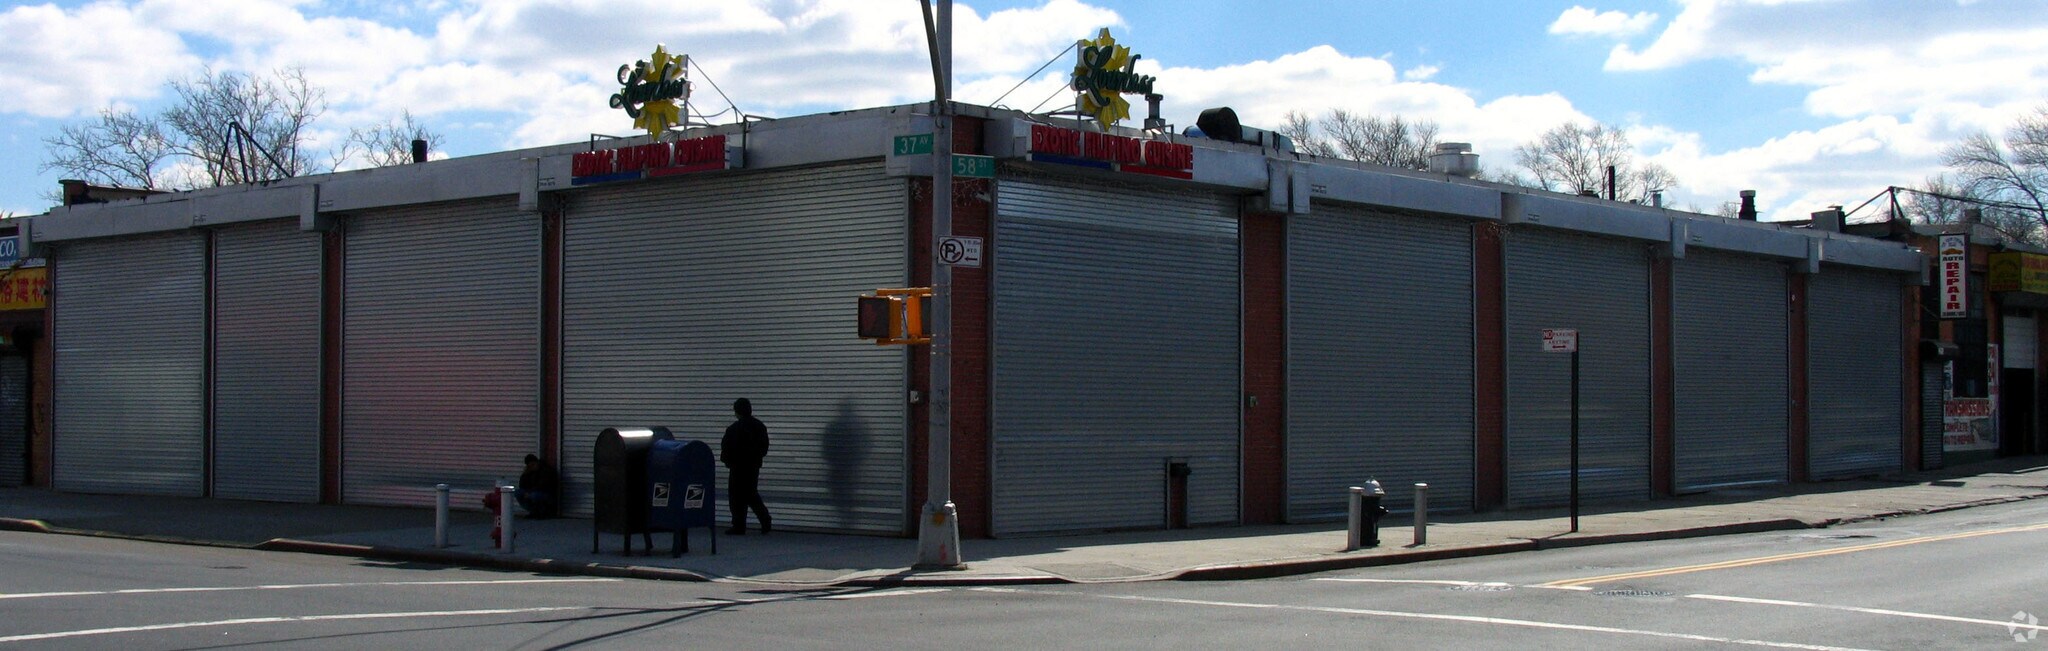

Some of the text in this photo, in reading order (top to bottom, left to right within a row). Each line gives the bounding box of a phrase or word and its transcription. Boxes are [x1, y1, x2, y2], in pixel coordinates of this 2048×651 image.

[901, 136, 929, 154] 37 AV
[1032, 125, 1193, 169] EXOTIC FILIPINO CUISINE
[958, 158, 987, 175] 58 ST
[1946, 262, 1960, 310] REPAIR
[1543, 330, 1553, 339] NO
